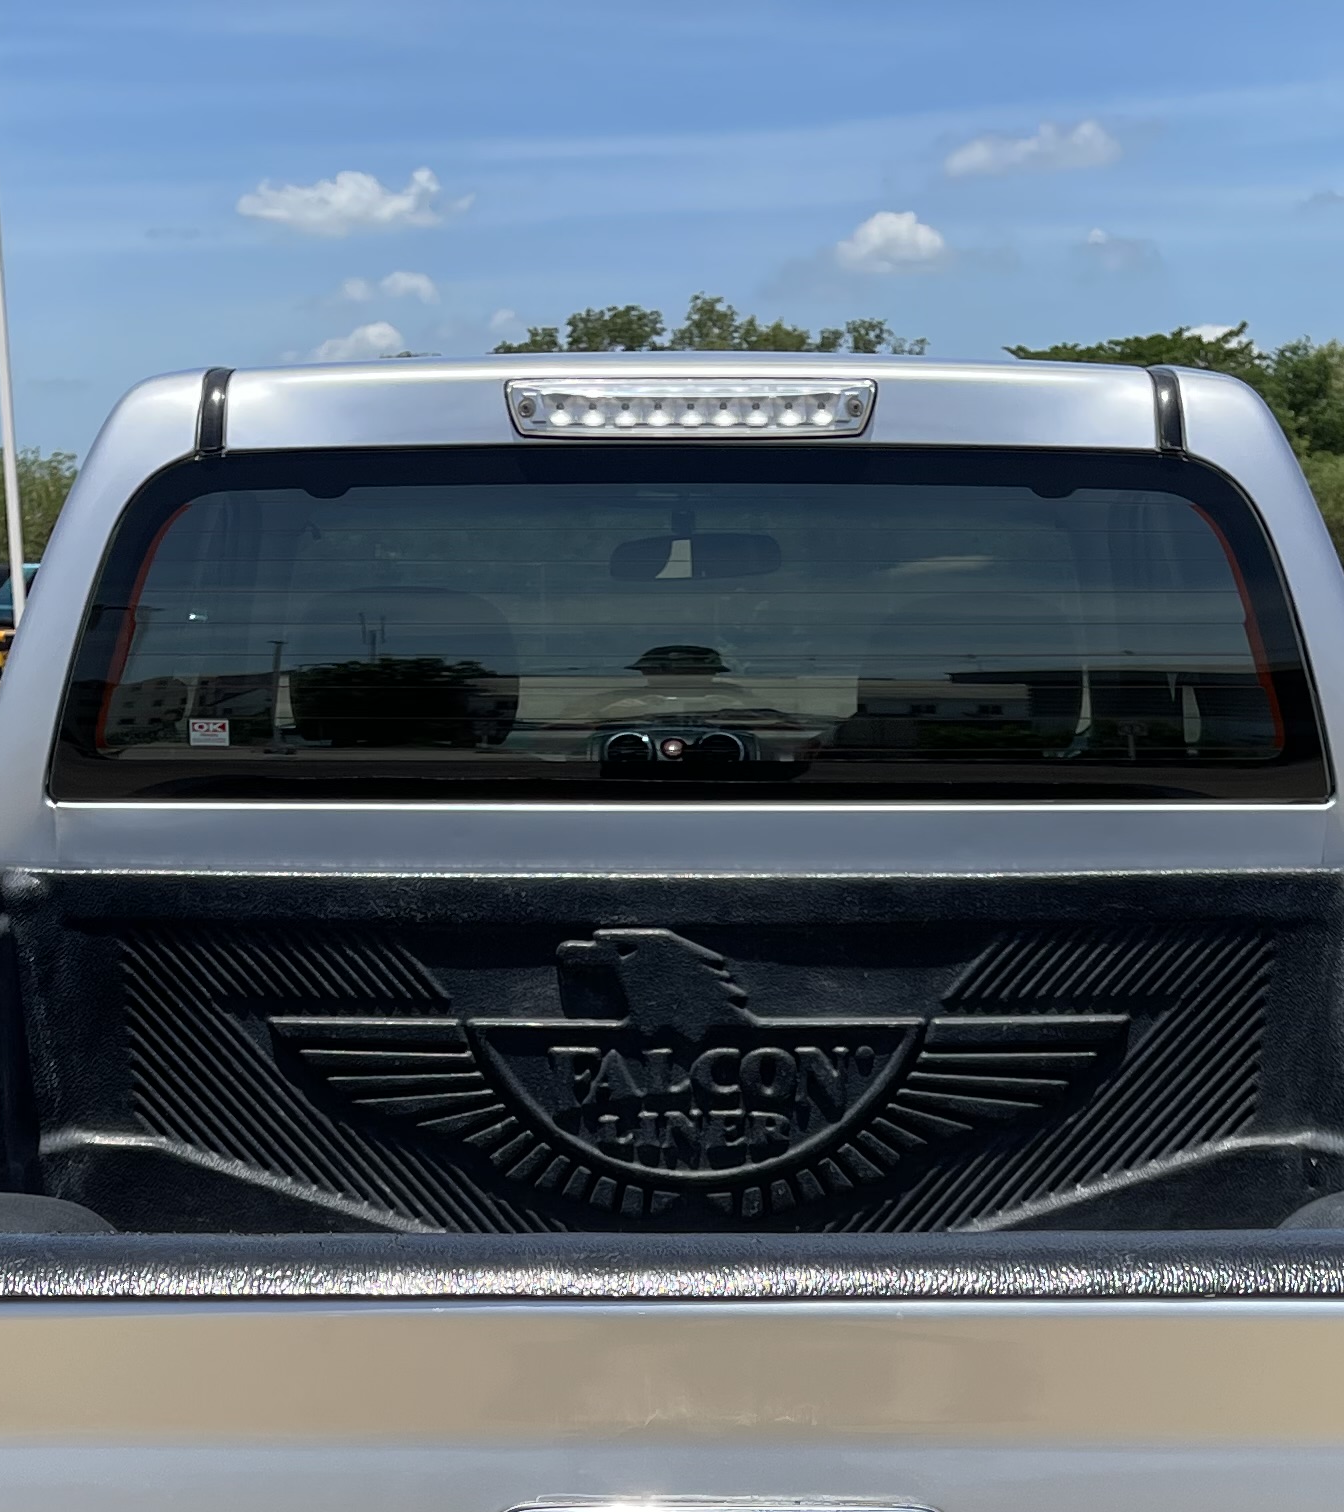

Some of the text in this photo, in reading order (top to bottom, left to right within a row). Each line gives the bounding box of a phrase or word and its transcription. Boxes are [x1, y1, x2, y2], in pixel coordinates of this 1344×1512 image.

[194, 723, 223, 732] OK
[548, 1046, 850, 1112] FALCON
[596, 1108, 791, 1150] LINER
